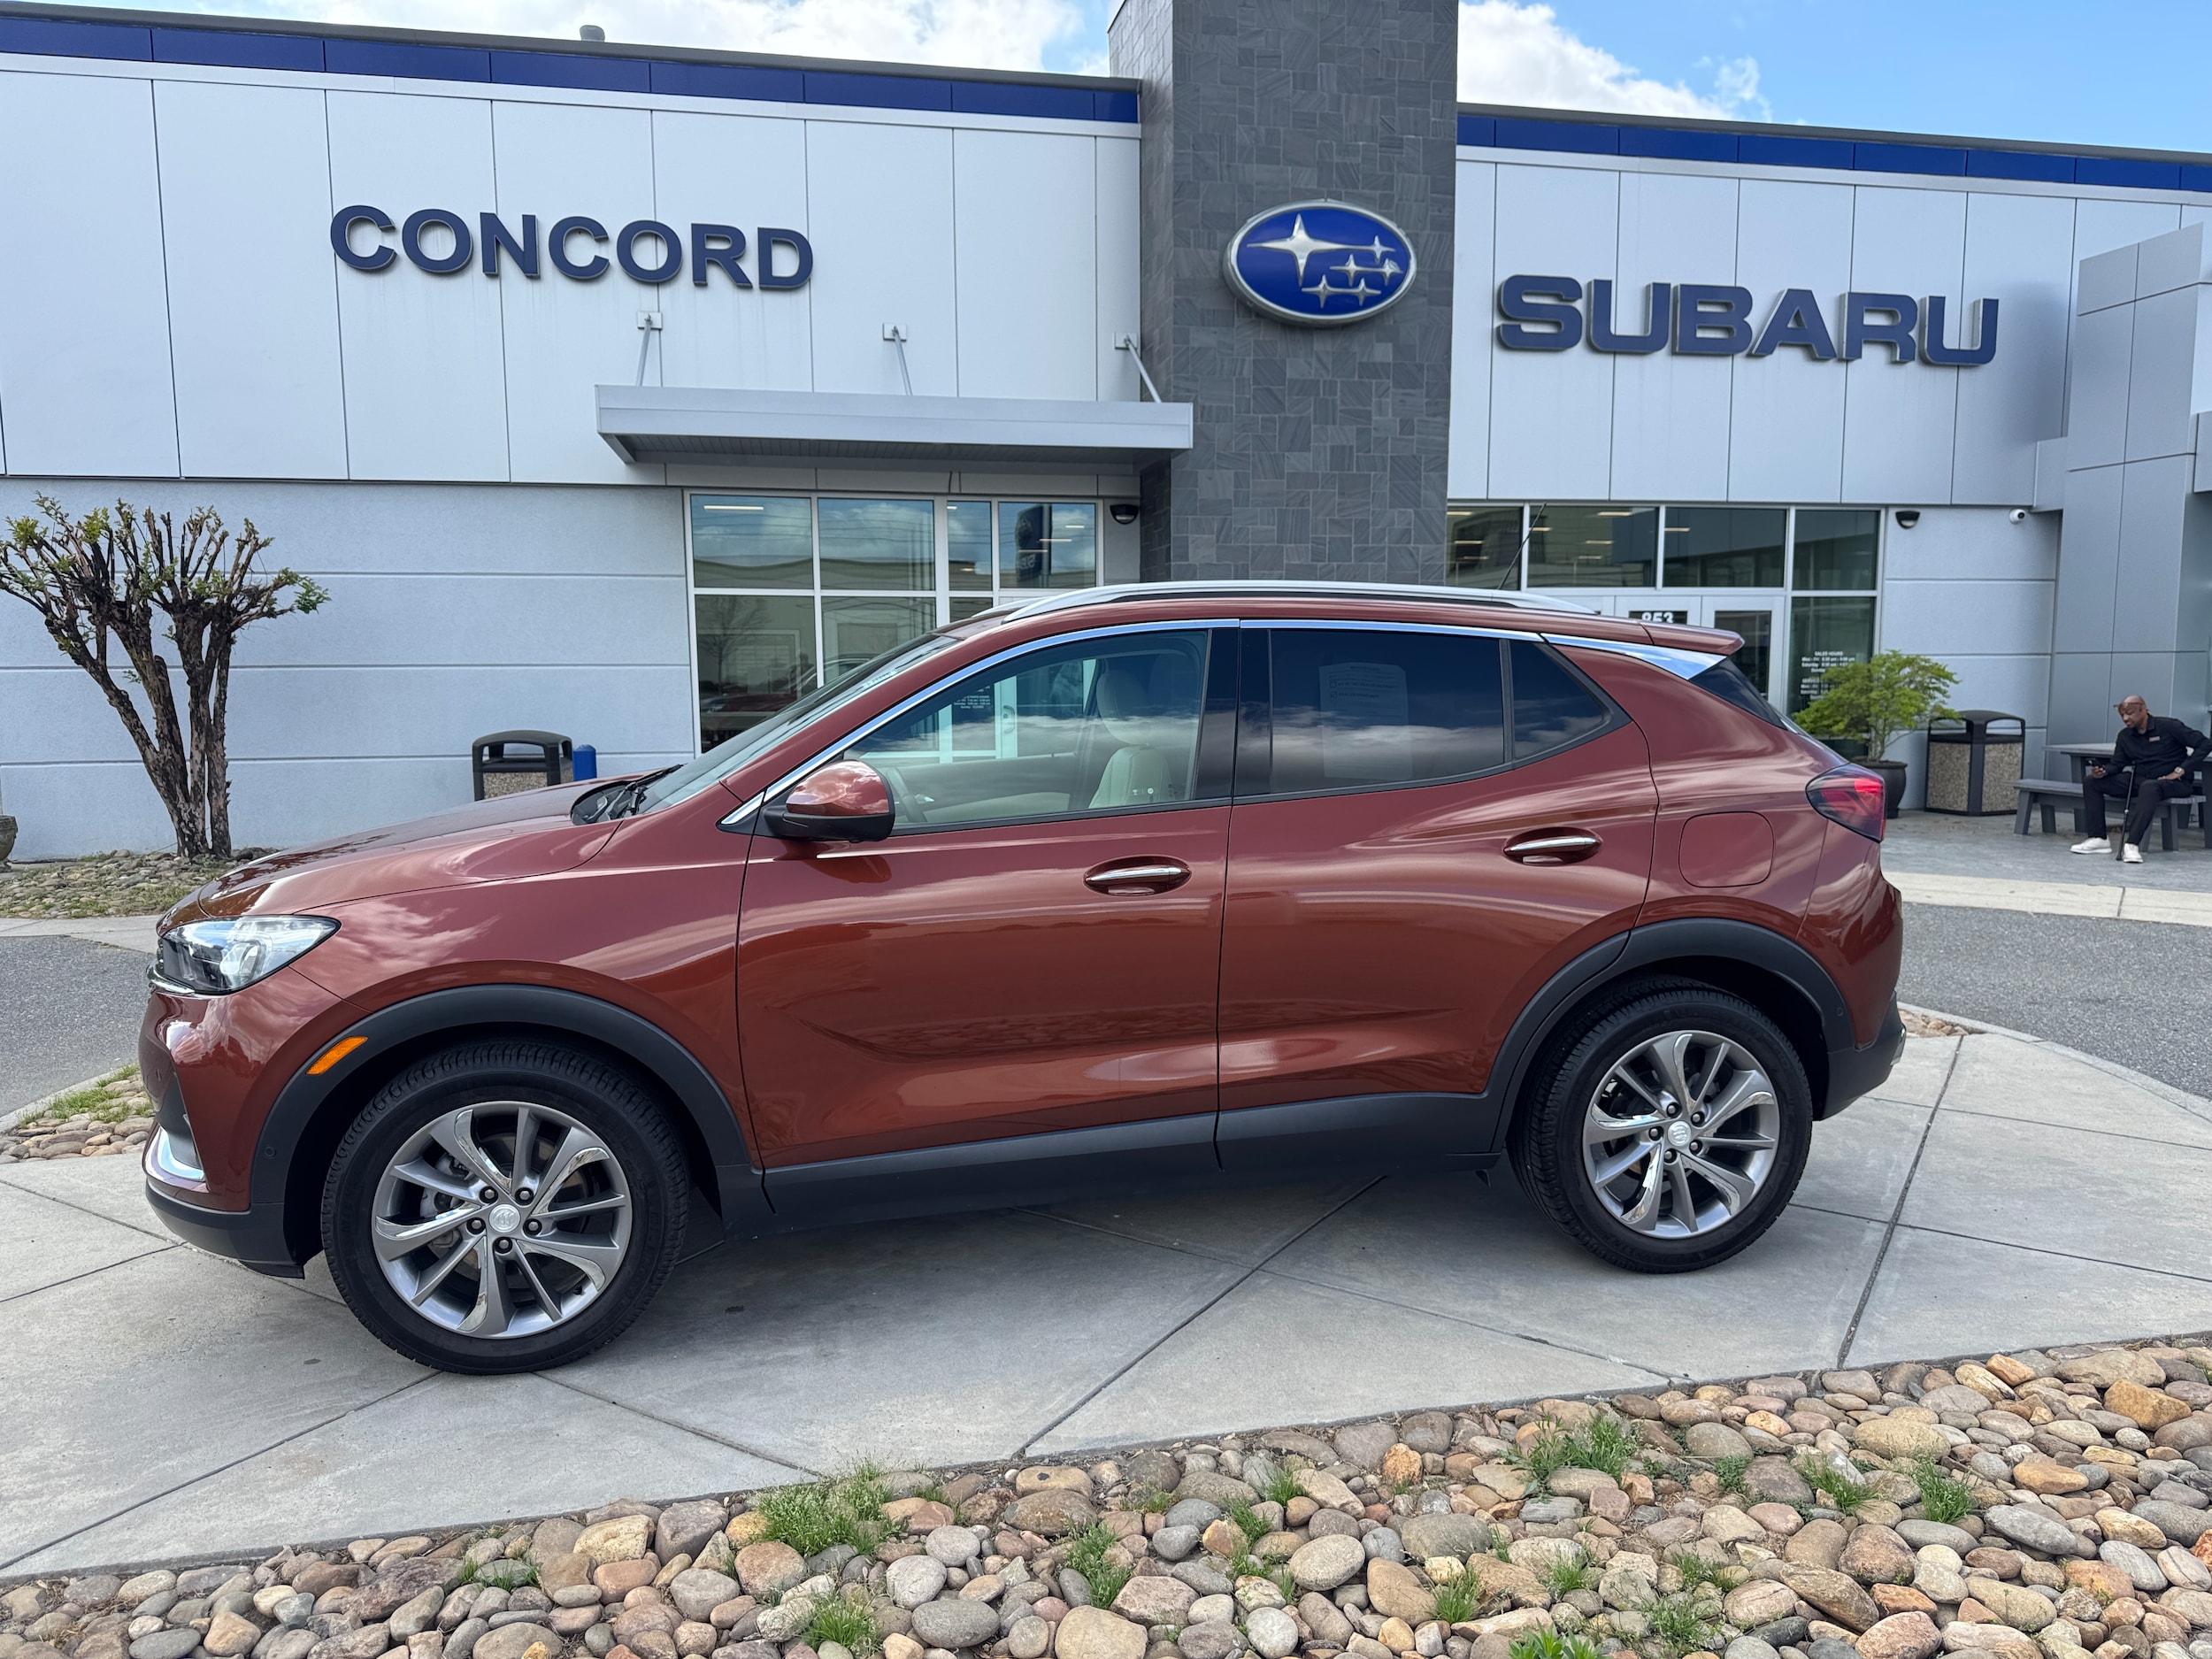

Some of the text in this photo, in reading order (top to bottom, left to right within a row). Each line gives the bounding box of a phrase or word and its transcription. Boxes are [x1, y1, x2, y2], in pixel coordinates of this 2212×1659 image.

[330, 204, 813, 290] CONCORD
[1496, 274, 2000, 365] SUBARU
[1641, 611, 1673, 623] 853
